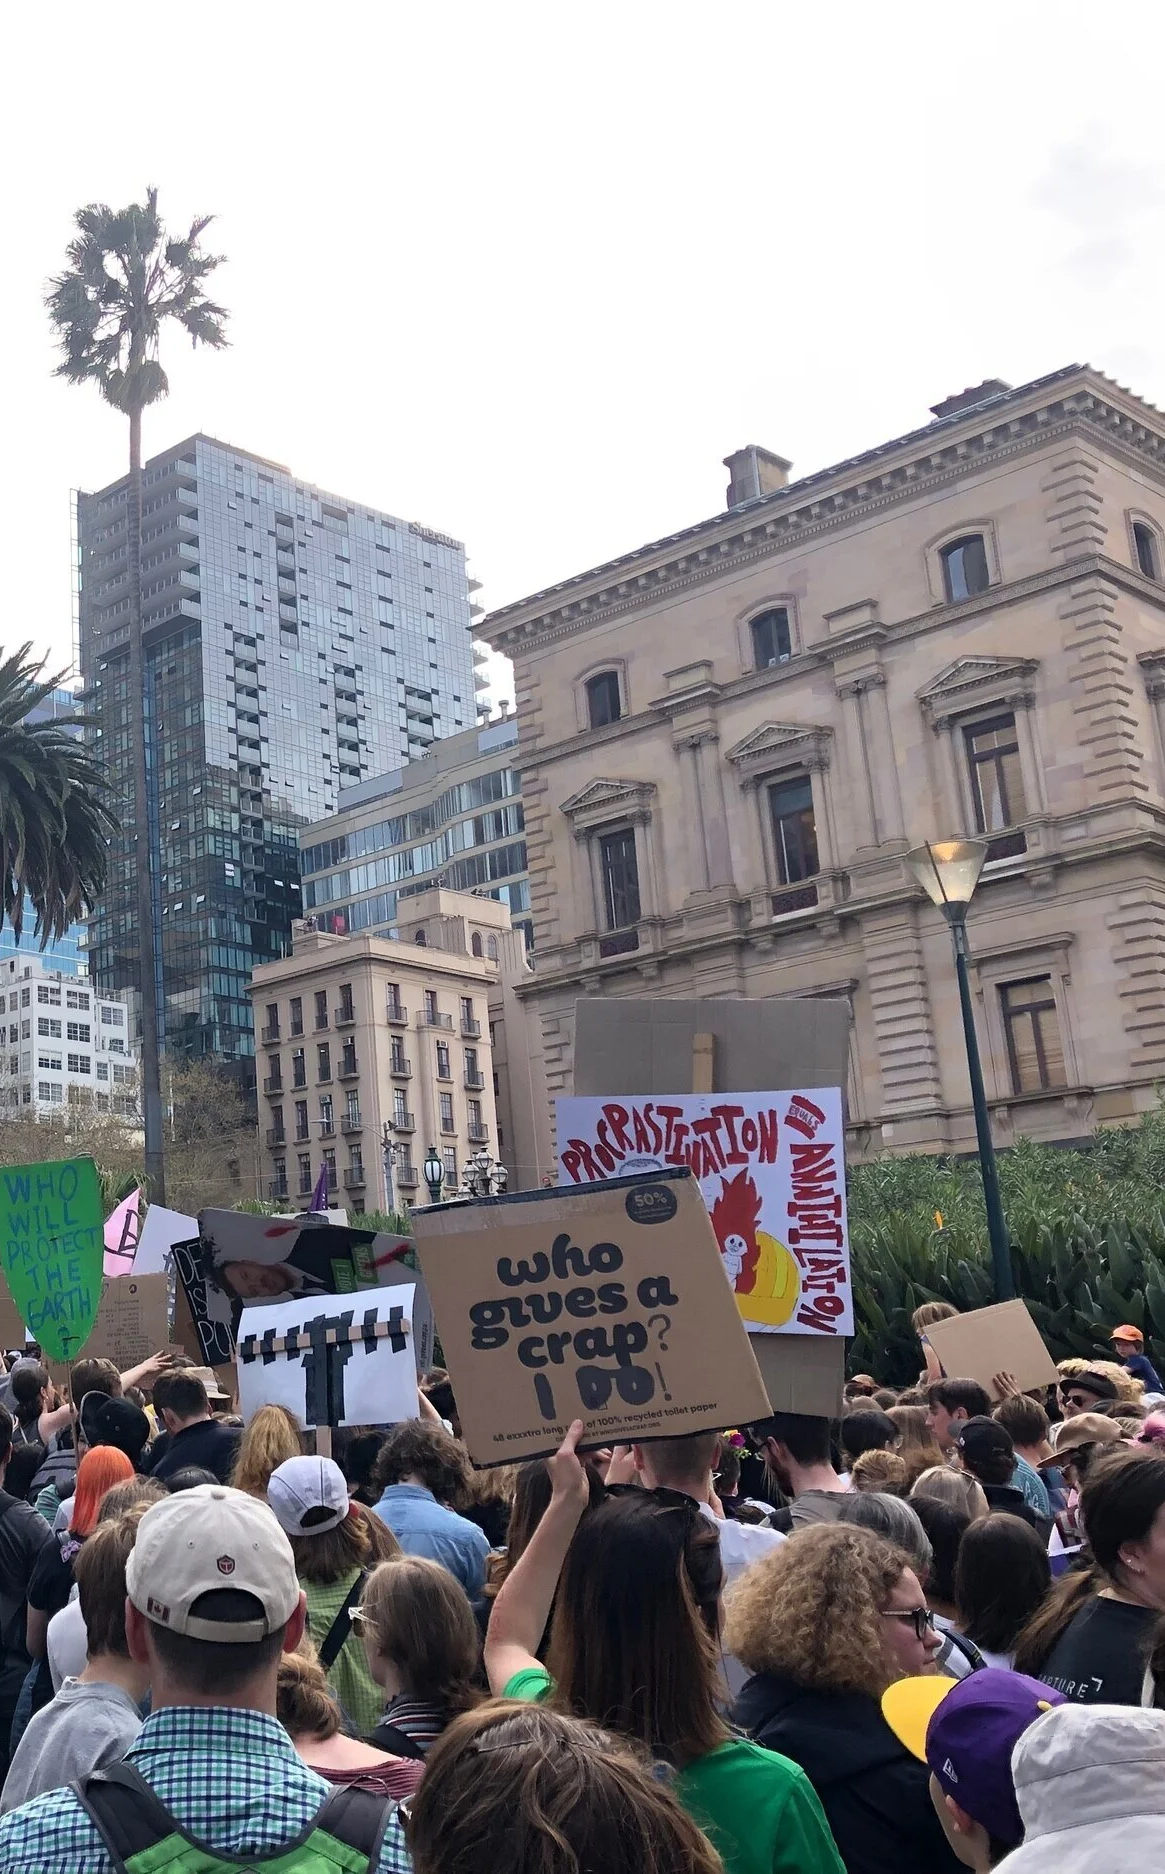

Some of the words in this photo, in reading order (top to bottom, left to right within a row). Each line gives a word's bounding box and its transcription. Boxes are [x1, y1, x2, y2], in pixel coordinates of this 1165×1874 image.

[788, 1104, 820, 1131] EQUALS
[560, 1102, 779, 1183] PROCRASTINATION
[4, 1165, 78, 1205] WHO
[634, 1191, 668, 1207] 50%
[8, 1202, 79, 1237] WILL
[786, 1142, 846, 1334] ANNIHILATION
[6, 1227, 100, 1271] PROTECT
[496, 1233, 624, 1287] who
[26, 1257, 82, 1291] THE
[28, 1287, 92, 1331] EARTH
[469, 1282, 629, 1350] gives
[637, 1275, 680, 1309] a
[517, 1313, 672, 1369] crap?
[534, 1372, 557, 1420] I
[542, 1426, 563, 1436] long
[587, 1420, 597, 1429] of
[598, 1416, 622, 1427] 100%
[624, 1410, 663, 1423] recycled
[664, 1406, 689, 1417] toilet
[690, 1402, 717, 1415] paper
